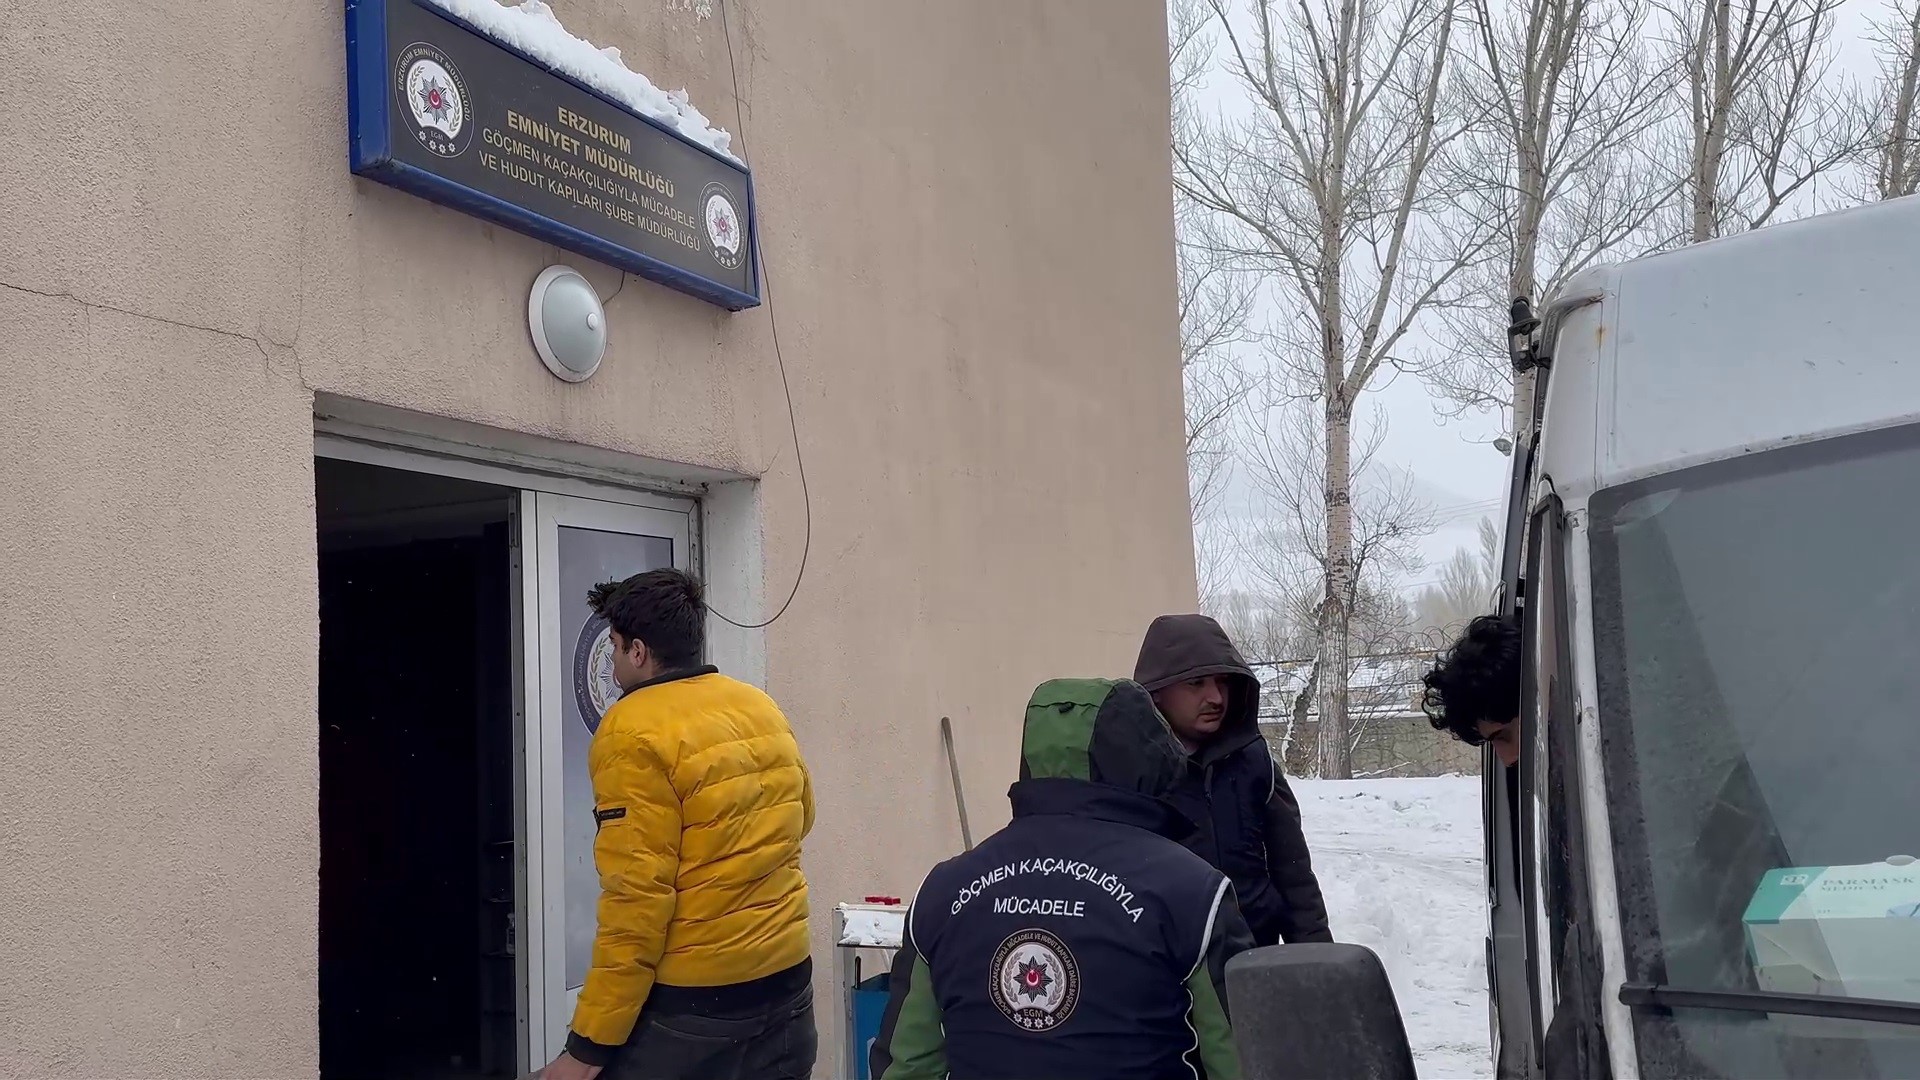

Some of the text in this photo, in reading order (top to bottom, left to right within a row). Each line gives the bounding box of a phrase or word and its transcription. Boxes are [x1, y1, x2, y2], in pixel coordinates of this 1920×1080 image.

[413, 48, 444, 65] EMNİYET
[507, 109, 675, 199] EMNİYET MÜDÜRLÜĞÜ
[557, 106, 632, 155] ERZURUM
[478, 150, 498, 171] VE
[501, 158, 545, 189] HUDUT
[547, 178, 603, 213] KAPILARI
[605, 202, 635, 227] ŞUBE
[637, 216, 702, 252] MÜDÜRLÜĞÜ
[482, 128, 540, 164] GÖÇMEN
[543, 154, 639, 206] KAÇAKÇILIĞIYLA
[641, 196, 696, 230] MÜCADELE
[950, 857, 1145, 923] GÖÇMEN KAÇAKÇILIĞIYLA
[993, 896, 1086, 917] MÜCADELE
[1023, 1008, 1044, 1018] EGM
